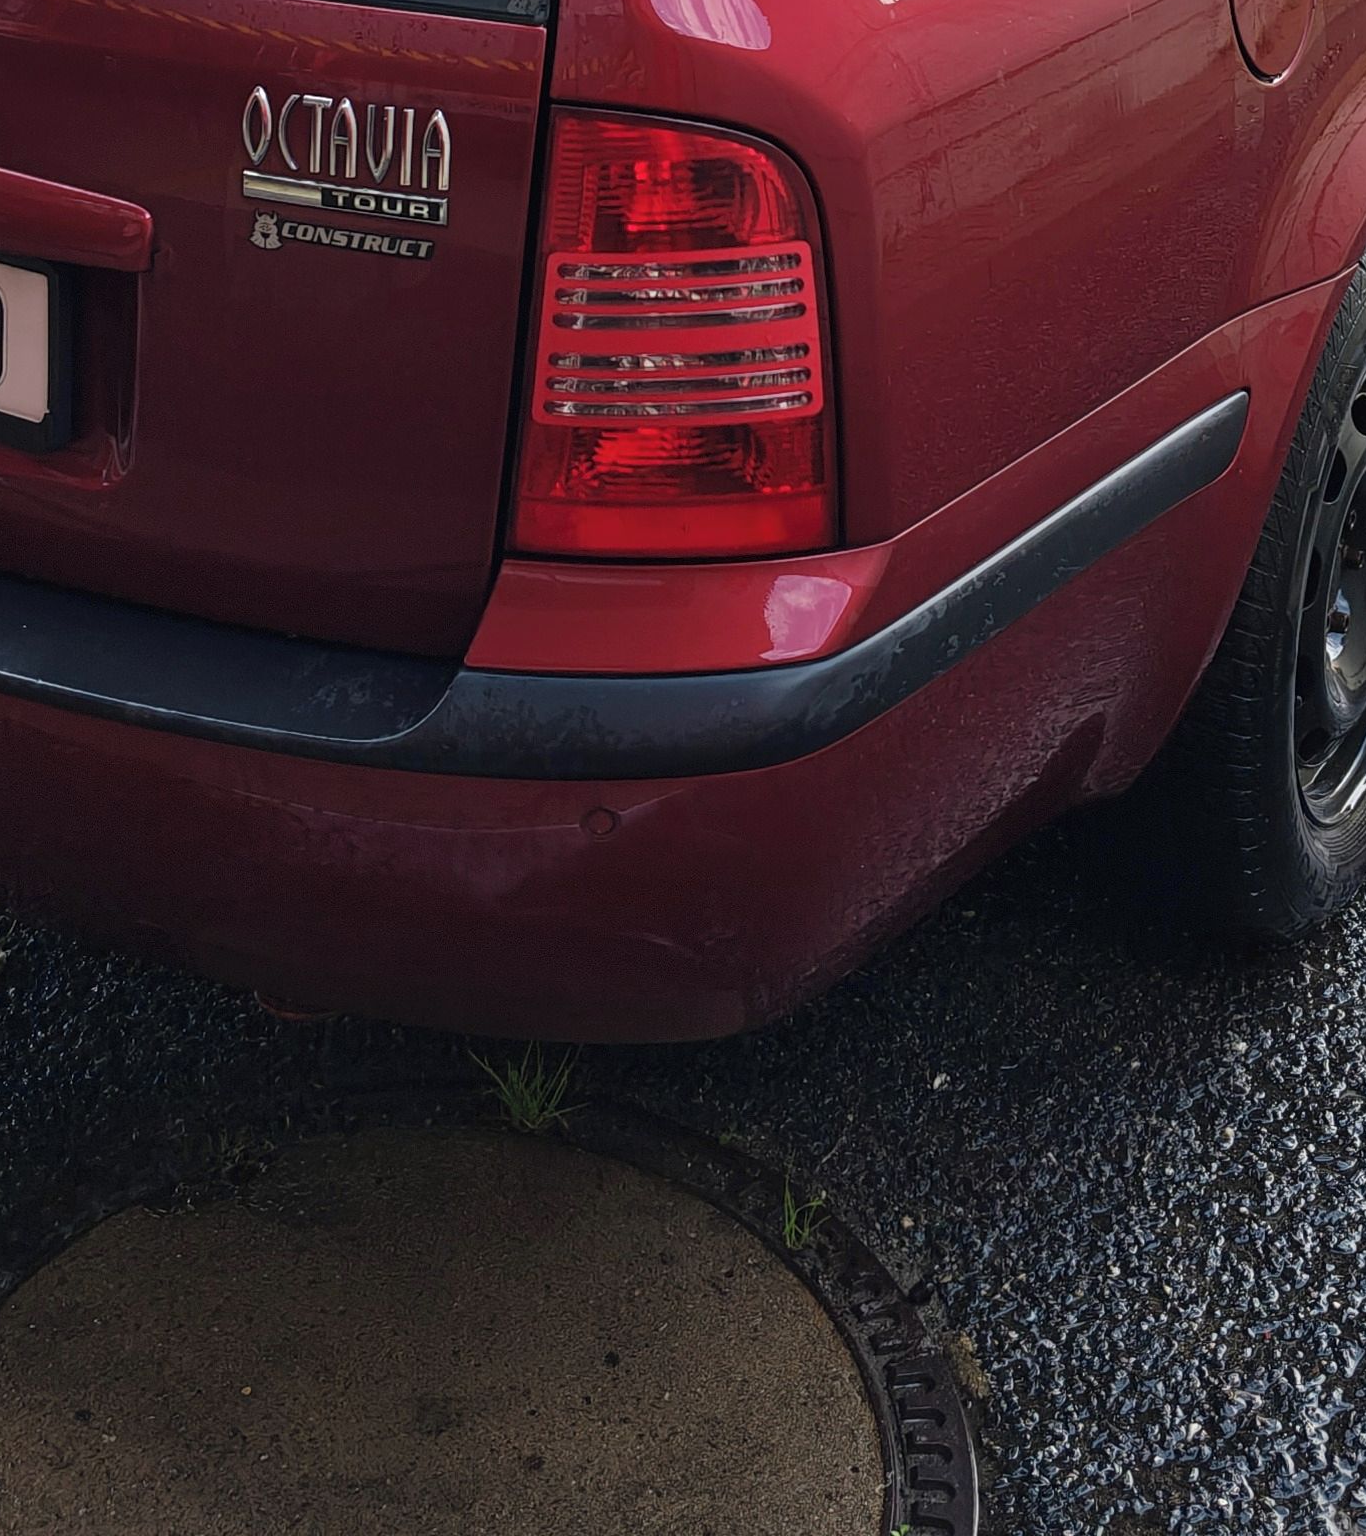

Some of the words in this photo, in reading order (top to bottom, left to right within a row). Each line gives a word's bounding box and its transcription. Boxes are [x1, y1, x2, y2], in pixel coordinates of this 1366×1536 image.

[242, 85, 451, 191] OCTAVIA
[332, 191, 430, 219] TOUR
[281, 222, 433, 258] CONSTRUCT
